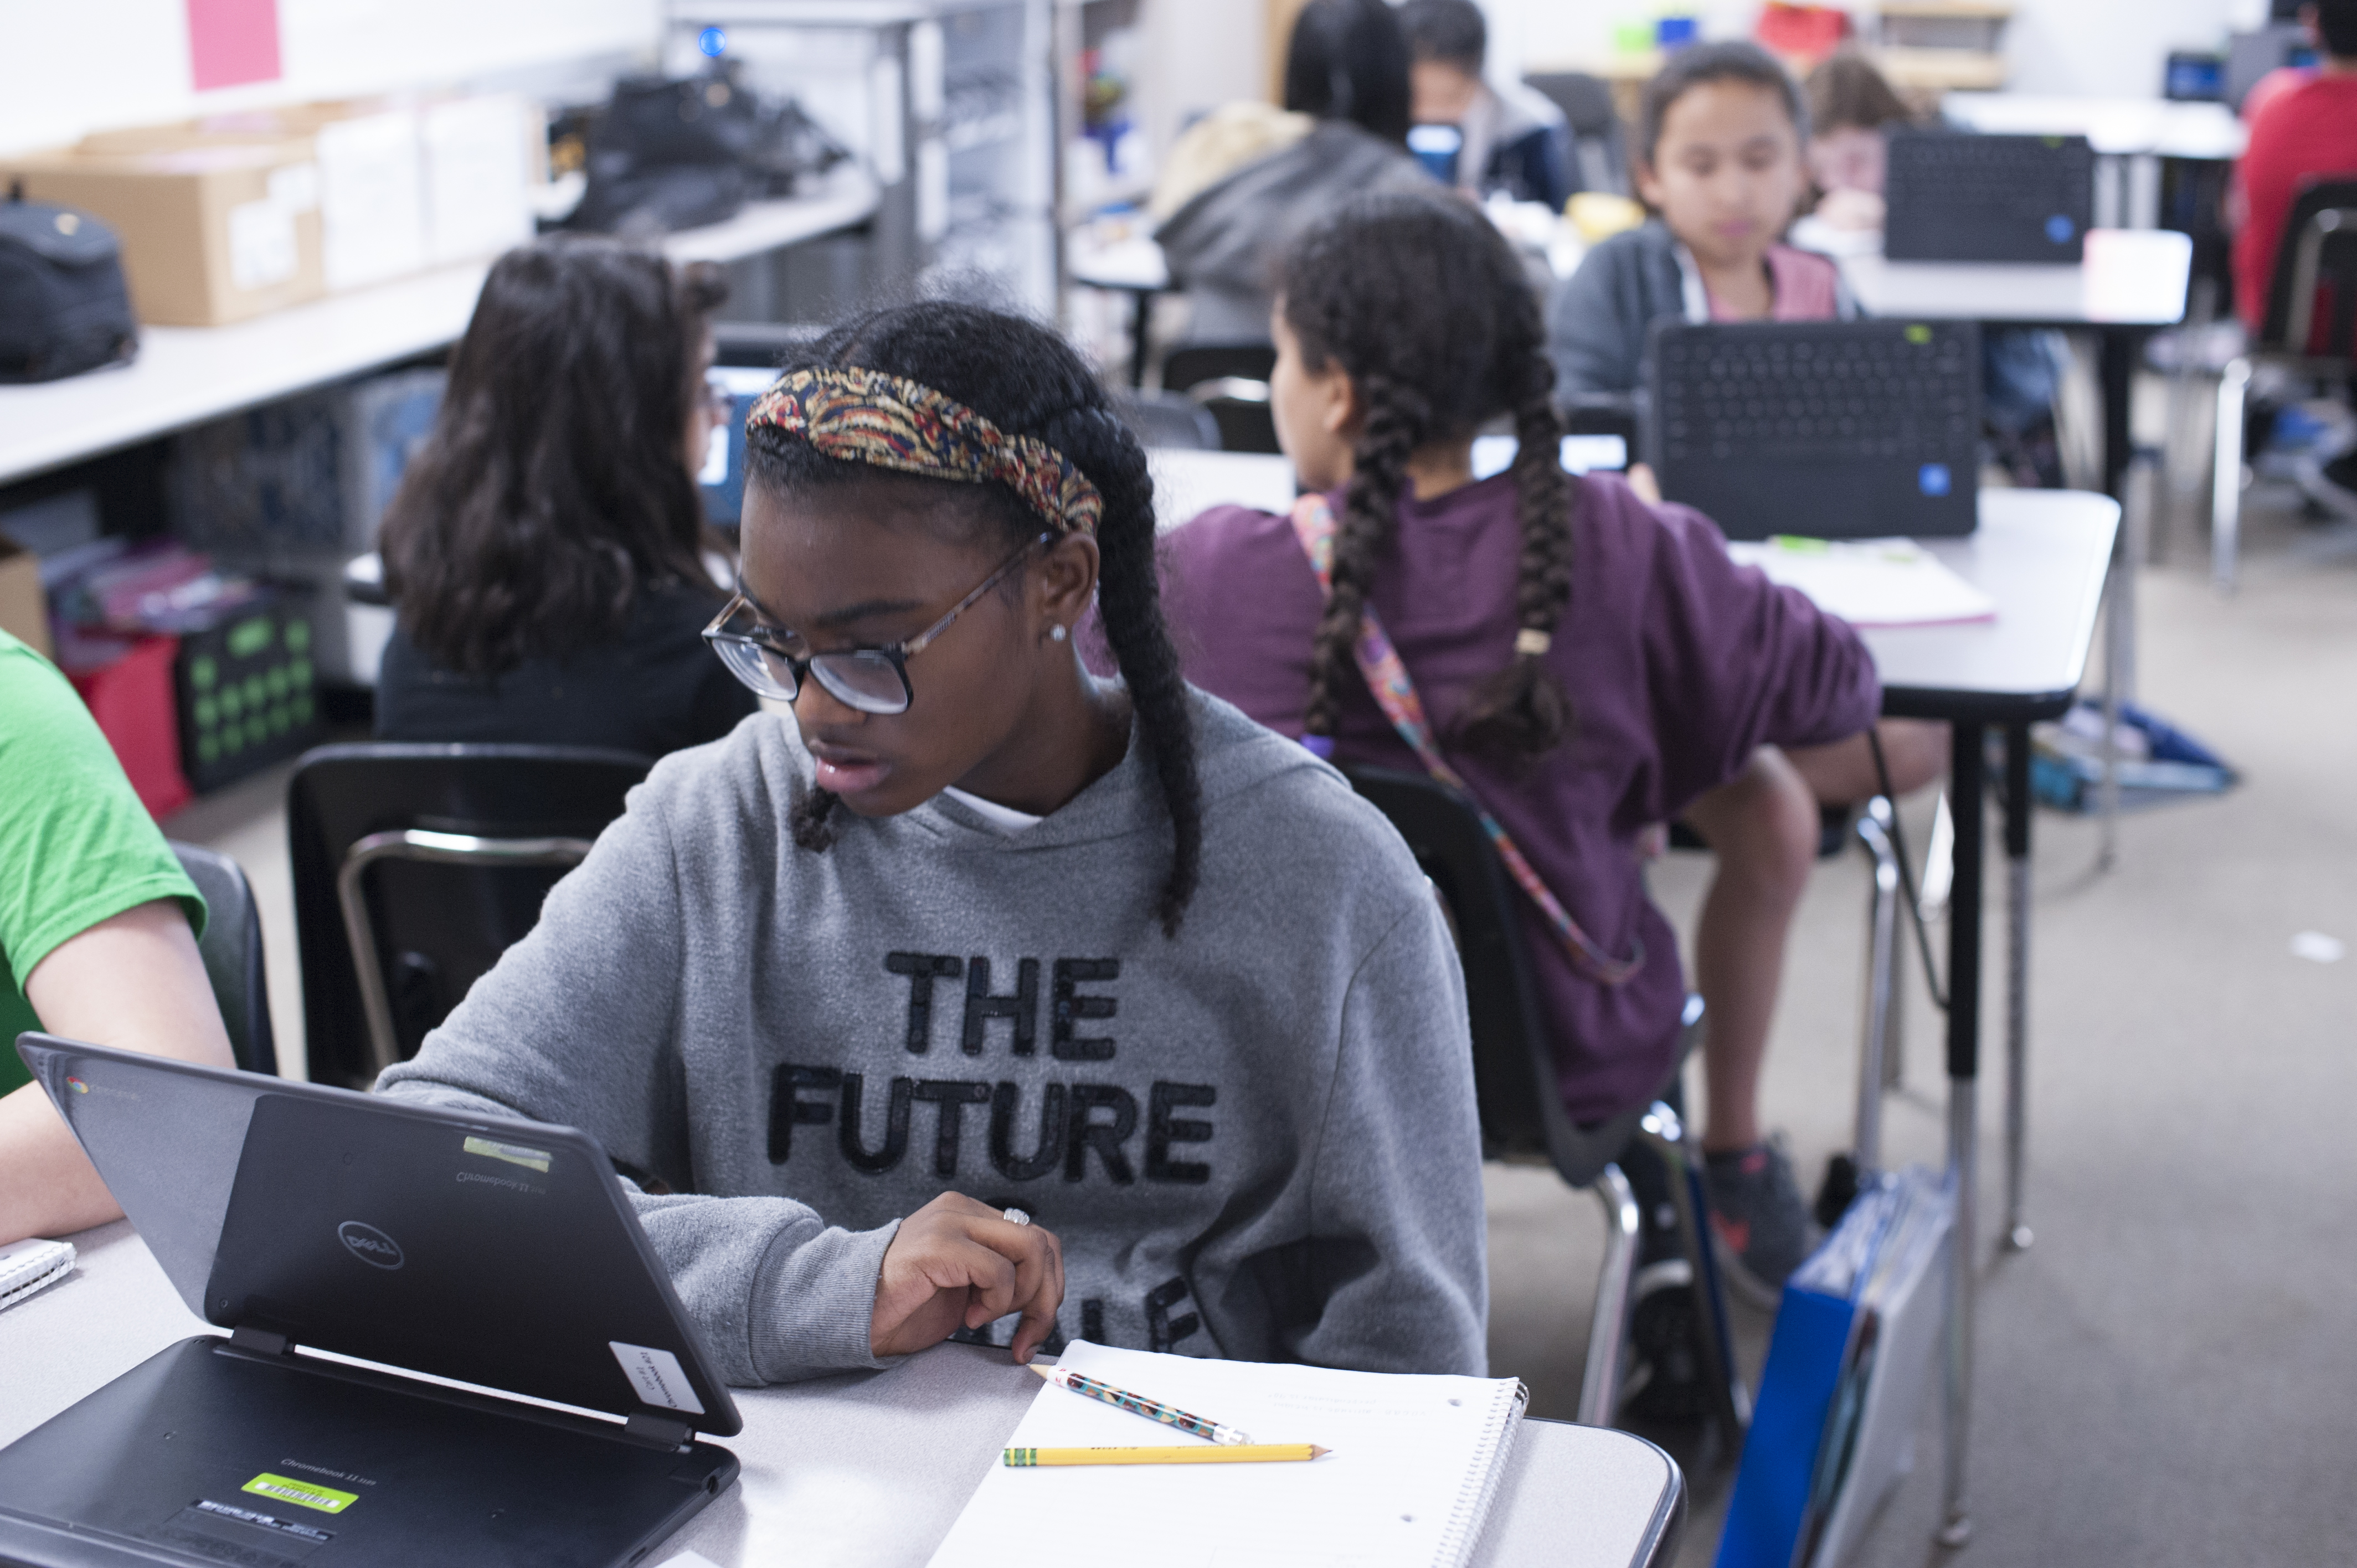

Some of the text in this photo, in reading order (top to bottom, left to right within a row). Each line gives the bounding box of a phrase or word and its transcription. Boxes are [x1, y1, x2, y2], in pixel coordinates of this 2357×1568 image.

[886, 951, 1120, 1061] THE
[768, 1063, 1217, 1185] FUTURE
[346, 1235, 398, 1256] DELL
[280, 1458, 345, 1479] Chromebook
[344, 1473, 359, 1482] 11
